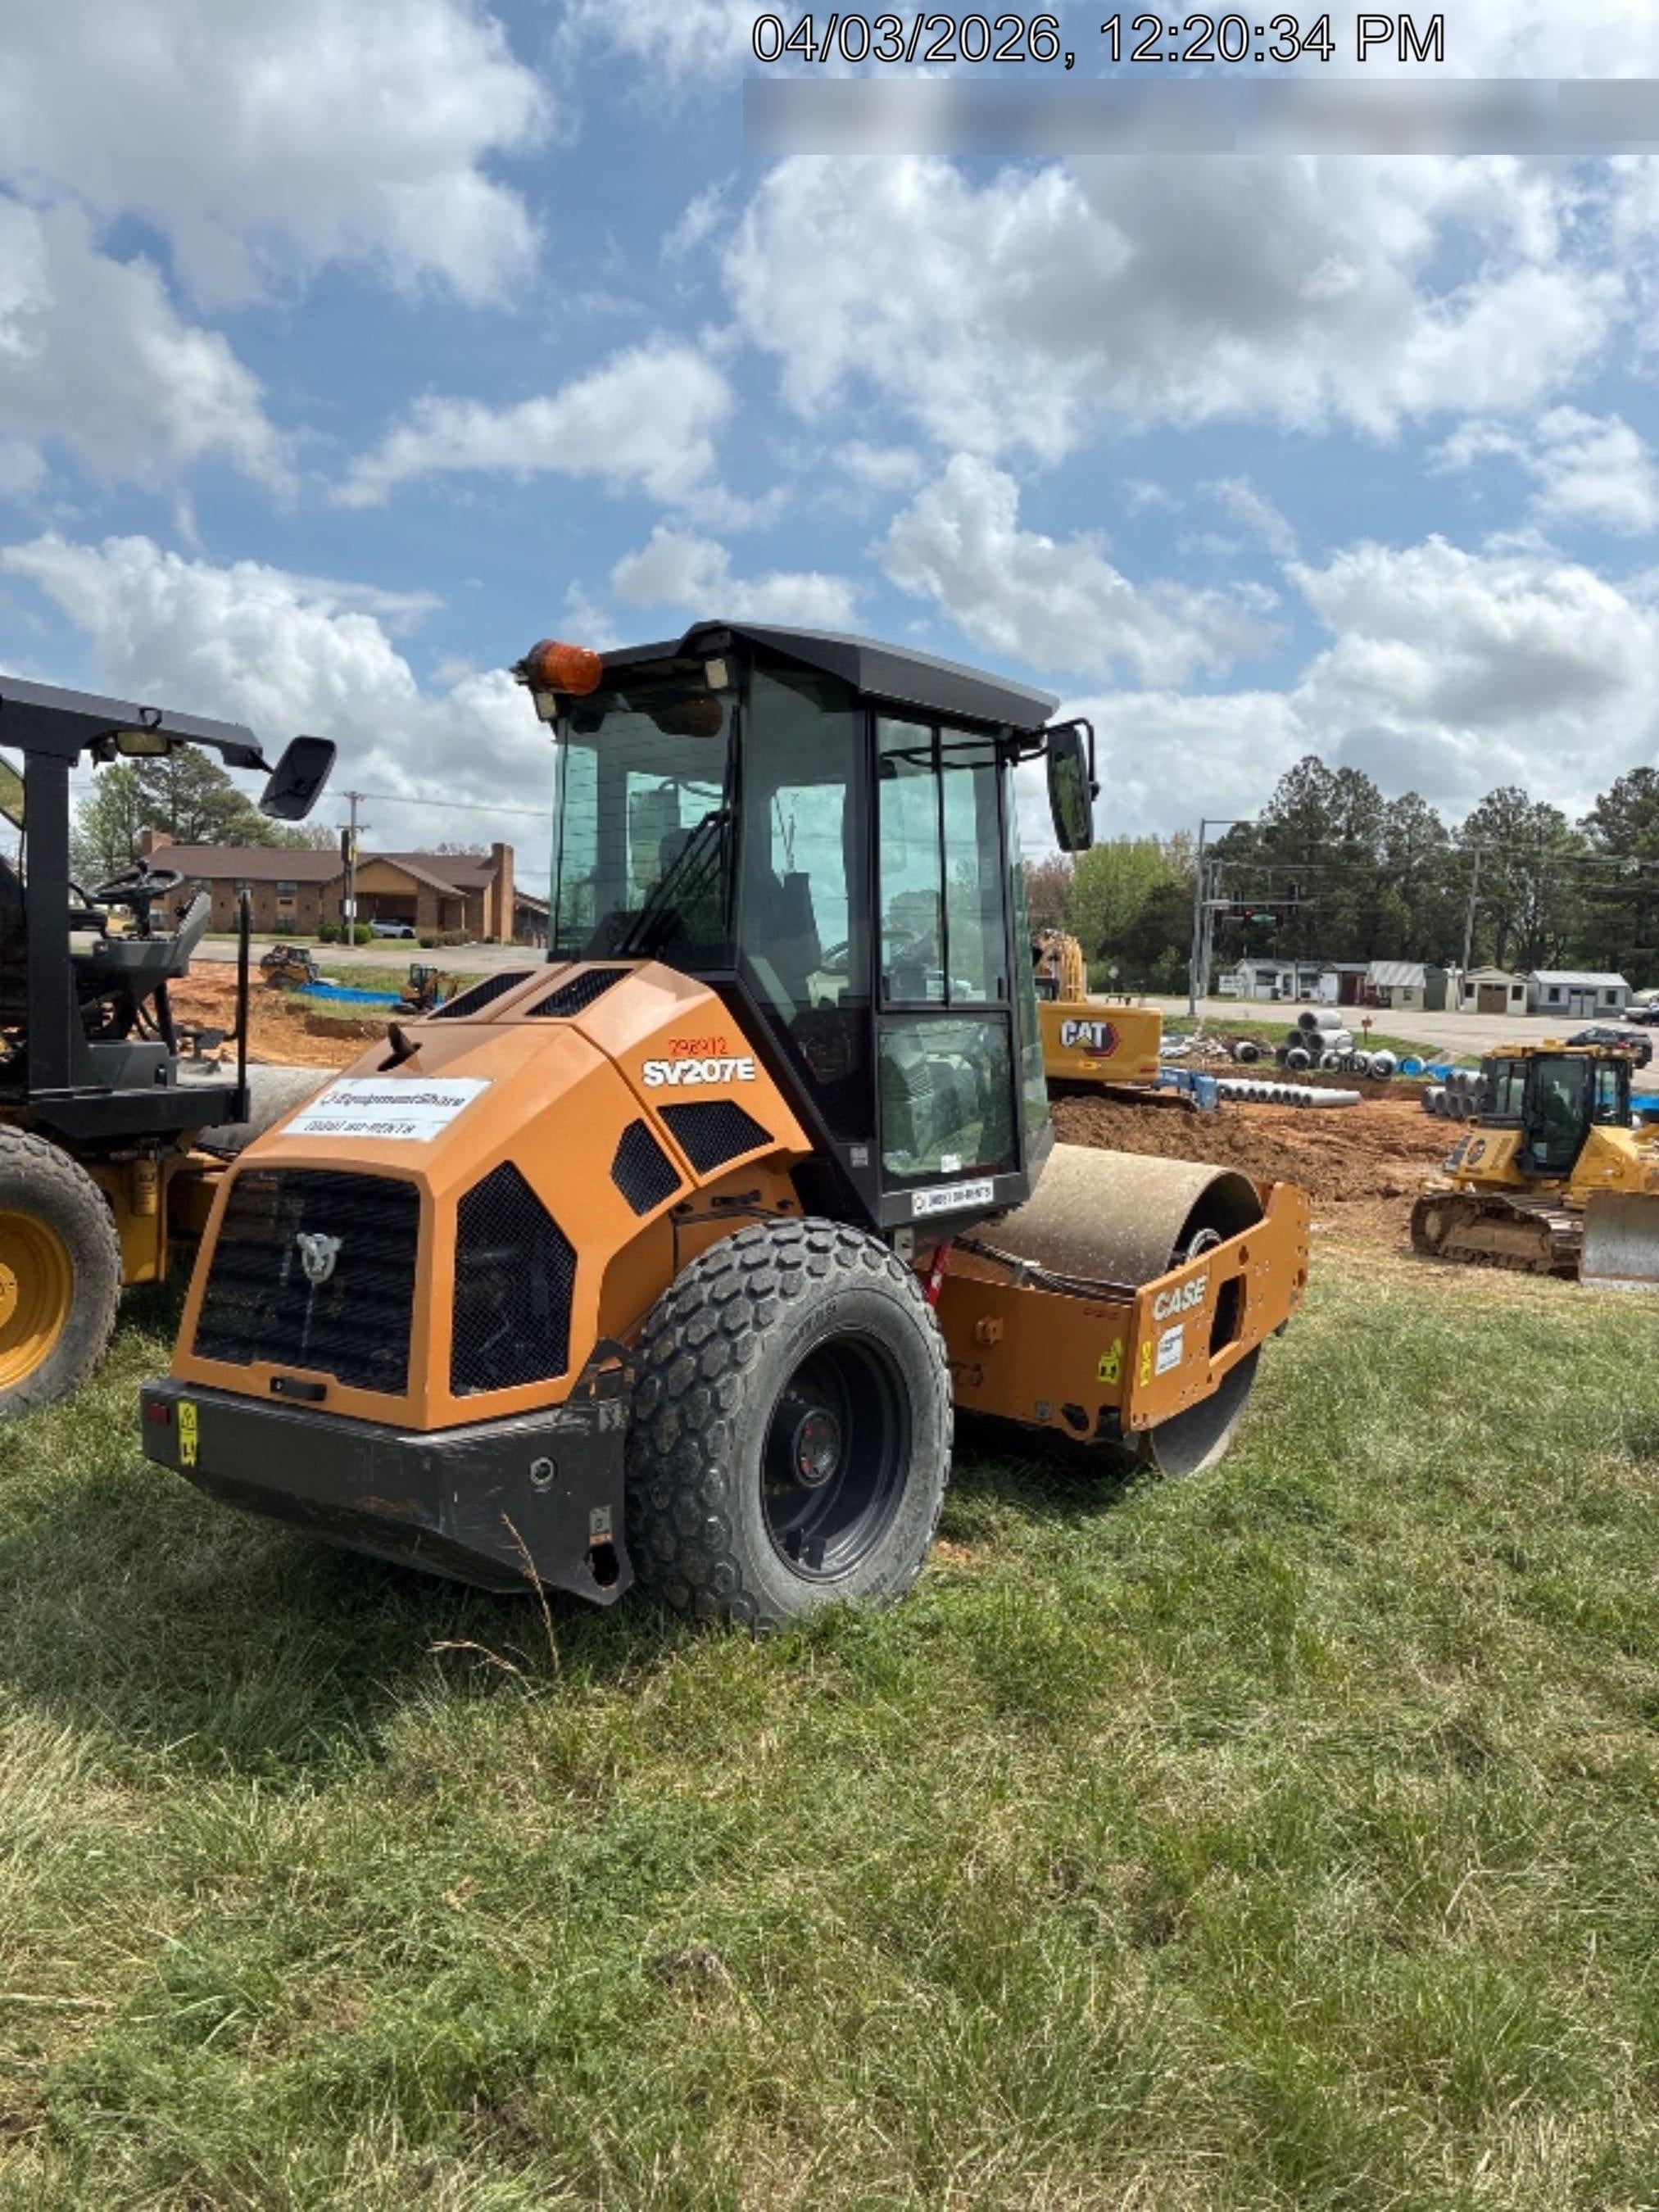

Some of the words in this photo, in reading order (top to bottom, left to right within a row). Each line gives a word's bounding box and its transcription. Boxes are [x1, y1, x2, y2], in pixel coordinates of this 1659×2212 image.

[1061, 1020, 1107, 1049] CAT
[642, 1058, 756, 1086] SV207E
[1154, 1275, 1208, 1321] CASE
